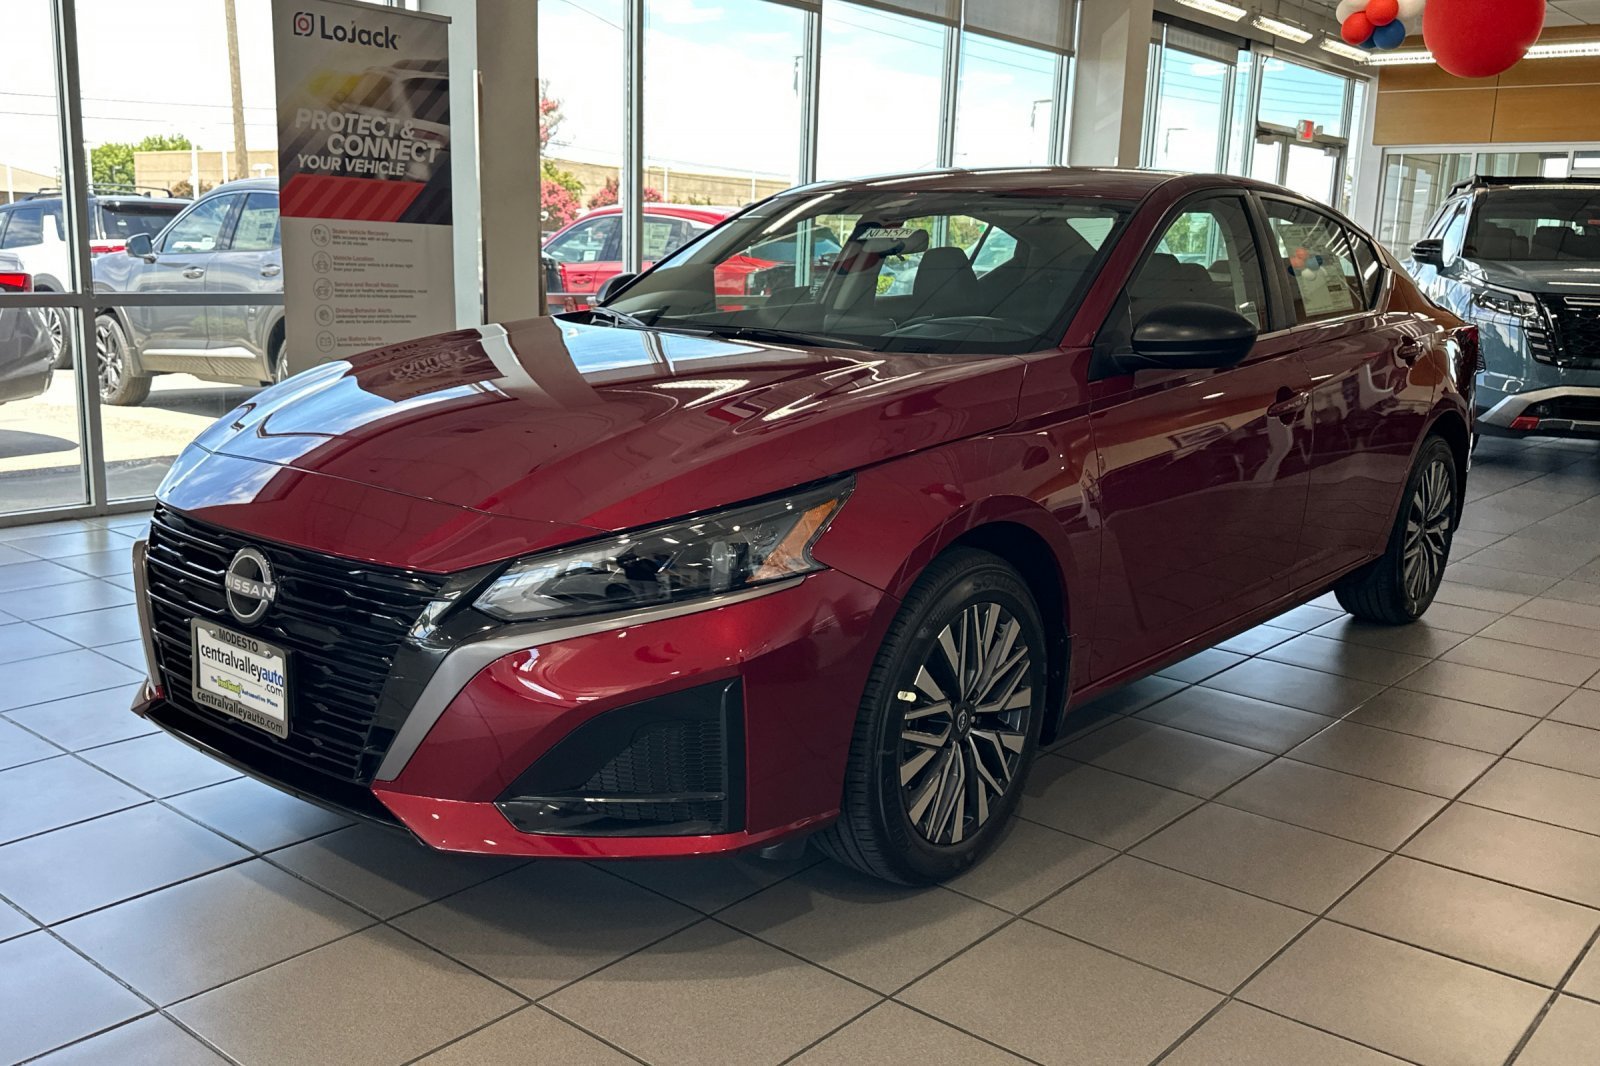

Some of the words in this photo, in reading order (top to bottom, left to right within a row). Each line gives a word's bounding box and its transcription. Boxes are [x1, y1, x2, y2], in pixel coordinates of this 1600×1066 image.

[295, 107, 399, 138] PROTECT
[400, 119, 415, 140] &
[327, 133, 441, 164] CONNECT
[297, 153, 340, 171] YOUR
[345, 158, 405, 176] VEHICLE
[226, 575, 273, 600] NISSAN
[218, 628, 259, 653] MODESTO
[201, 643, 284, 688] centralvalleyauto
[197, 691, 283, 734] centralvalleyauto.com
